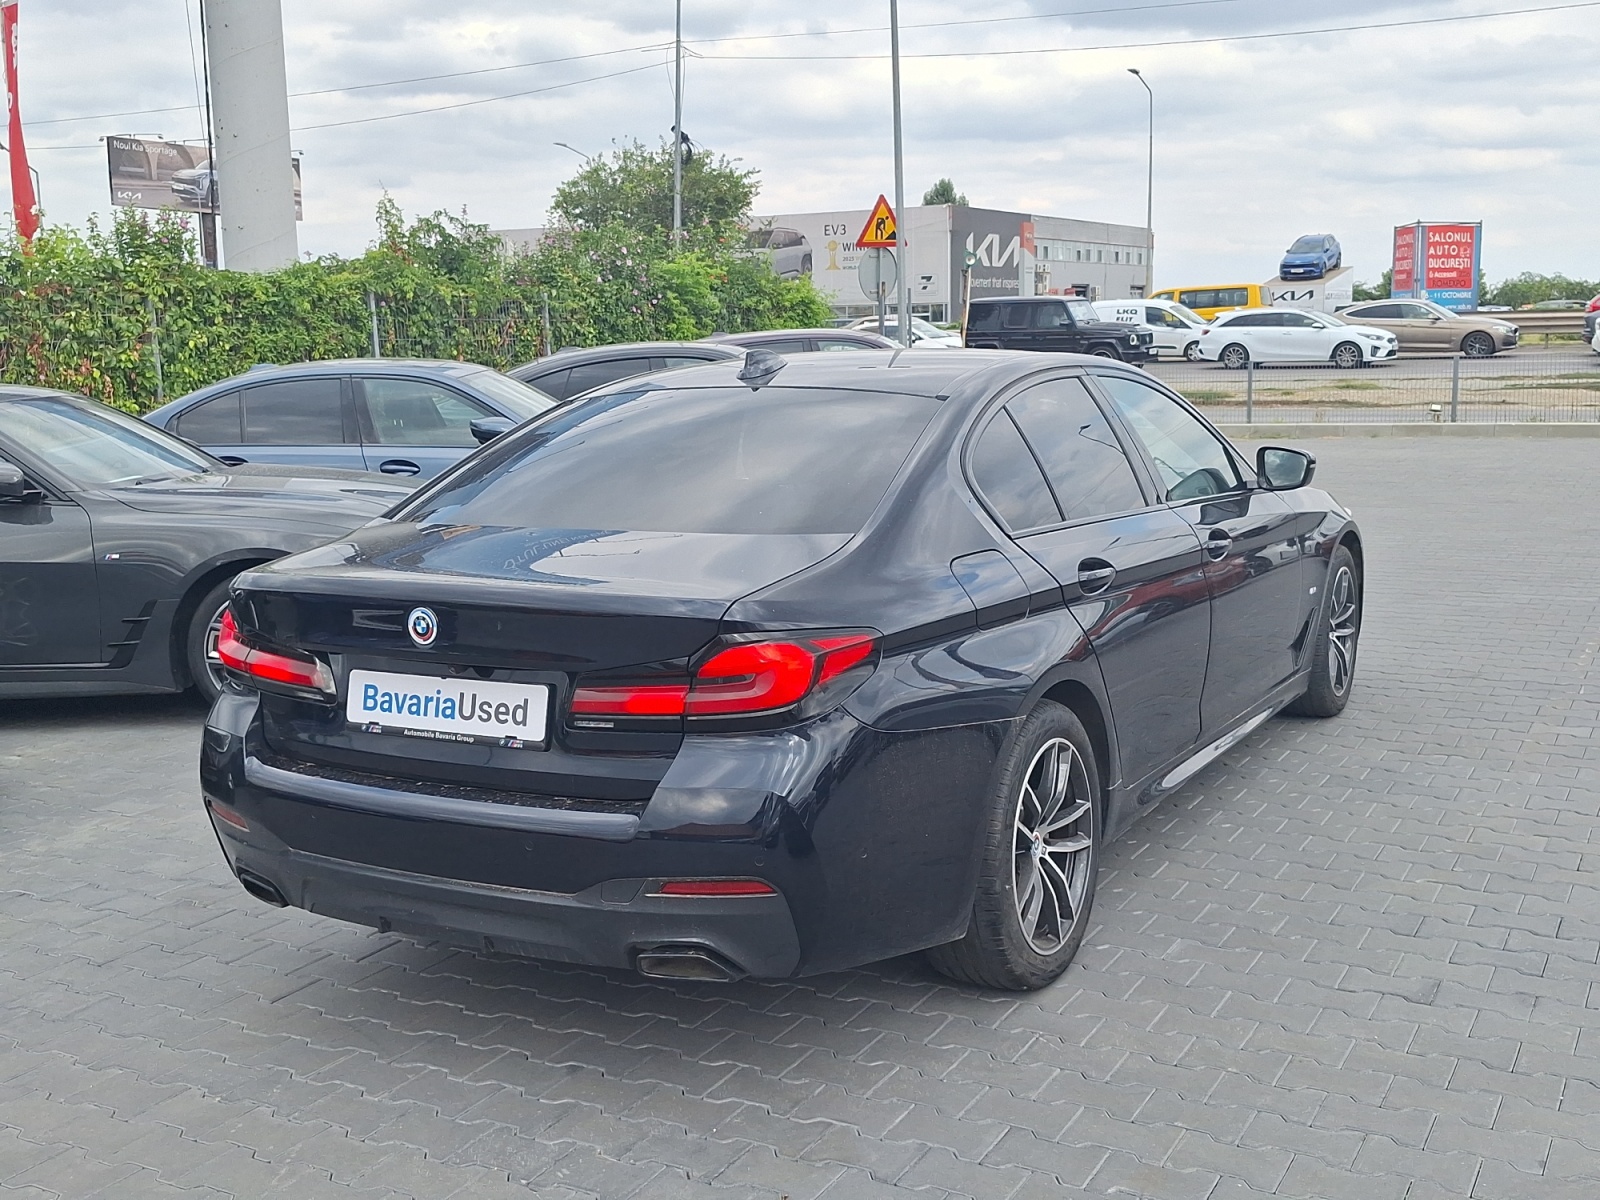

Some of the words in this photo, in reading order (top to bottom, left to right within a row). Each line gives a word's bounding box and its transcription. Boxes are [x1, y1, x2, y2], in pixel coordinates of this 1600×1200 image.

[114, 140, 130, 150] Noul
[132, 142, 143, 152] Kia
[145, 145, 177, 156] Sportage
[824, 224, 846, 236] EV3
[1428, 232, 1472, 242] SALONUL
[966, 232, 1020, 268] KIA
[1428, 246, 1458, 255] AUTO
[970, 278, 991, 288] ovement
[992, 278, 1002, 288] that
[362, 683, 529, 727] BavariaUsed
[404, 729, 434, 738] Automobile
[436, 732, 456, 741] Bavaria
[457, 735, 474, 743] Group
